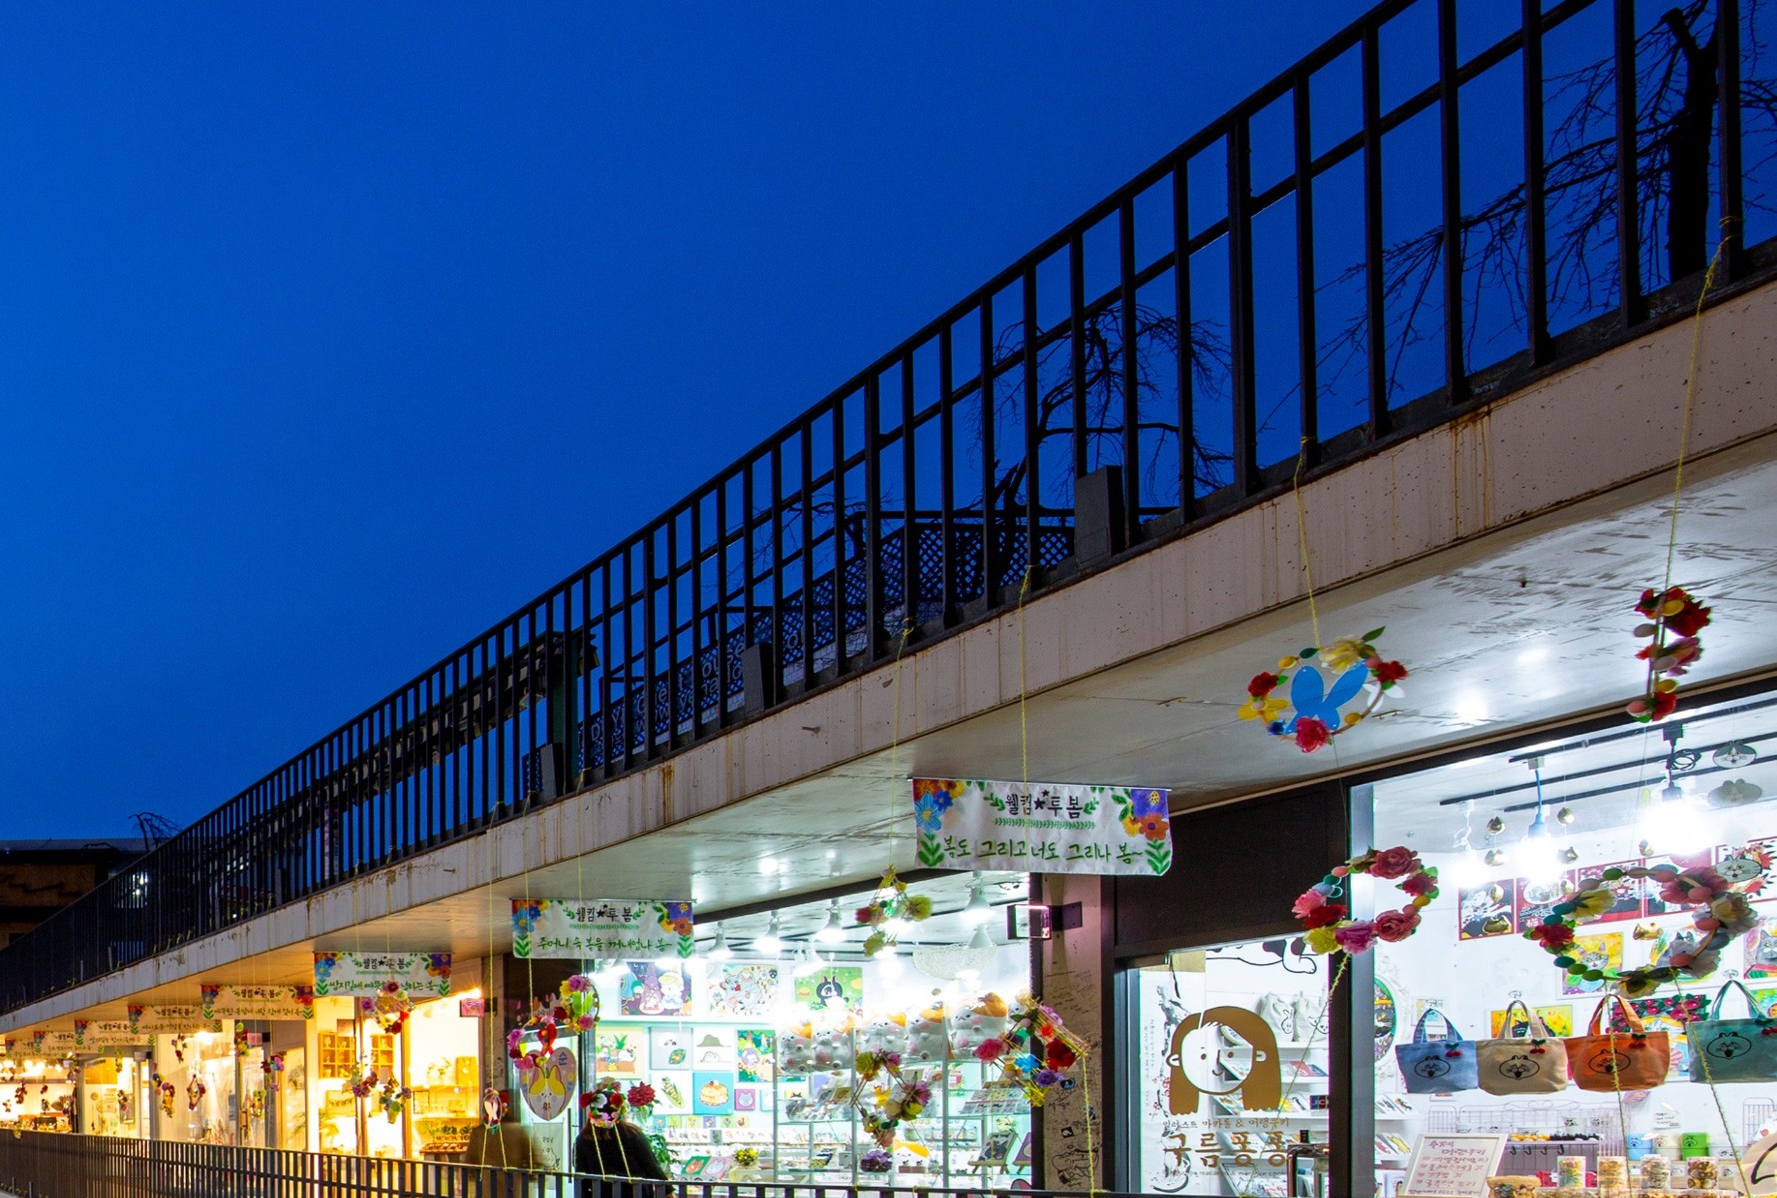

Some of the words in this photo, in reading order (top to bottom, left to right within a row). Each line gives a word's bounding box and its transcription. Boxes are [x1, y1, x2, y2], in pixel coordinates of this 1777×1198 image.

[1068, 794, 1084, 819] 봄
[942, 835, 972, 858] 봄도
[978, 839, 1027, 858] 그리고
[1030, 841, 1060, 861] 너도
[1065, 842, 1112, 862] 그리나
[621, 906, 634, 924] 봄
[537, 936, 570, 951] 주머니
[1163, 1119, 1198, 1129] 일러스트
[1202, 1118, 1232, 1129] 마카롱
